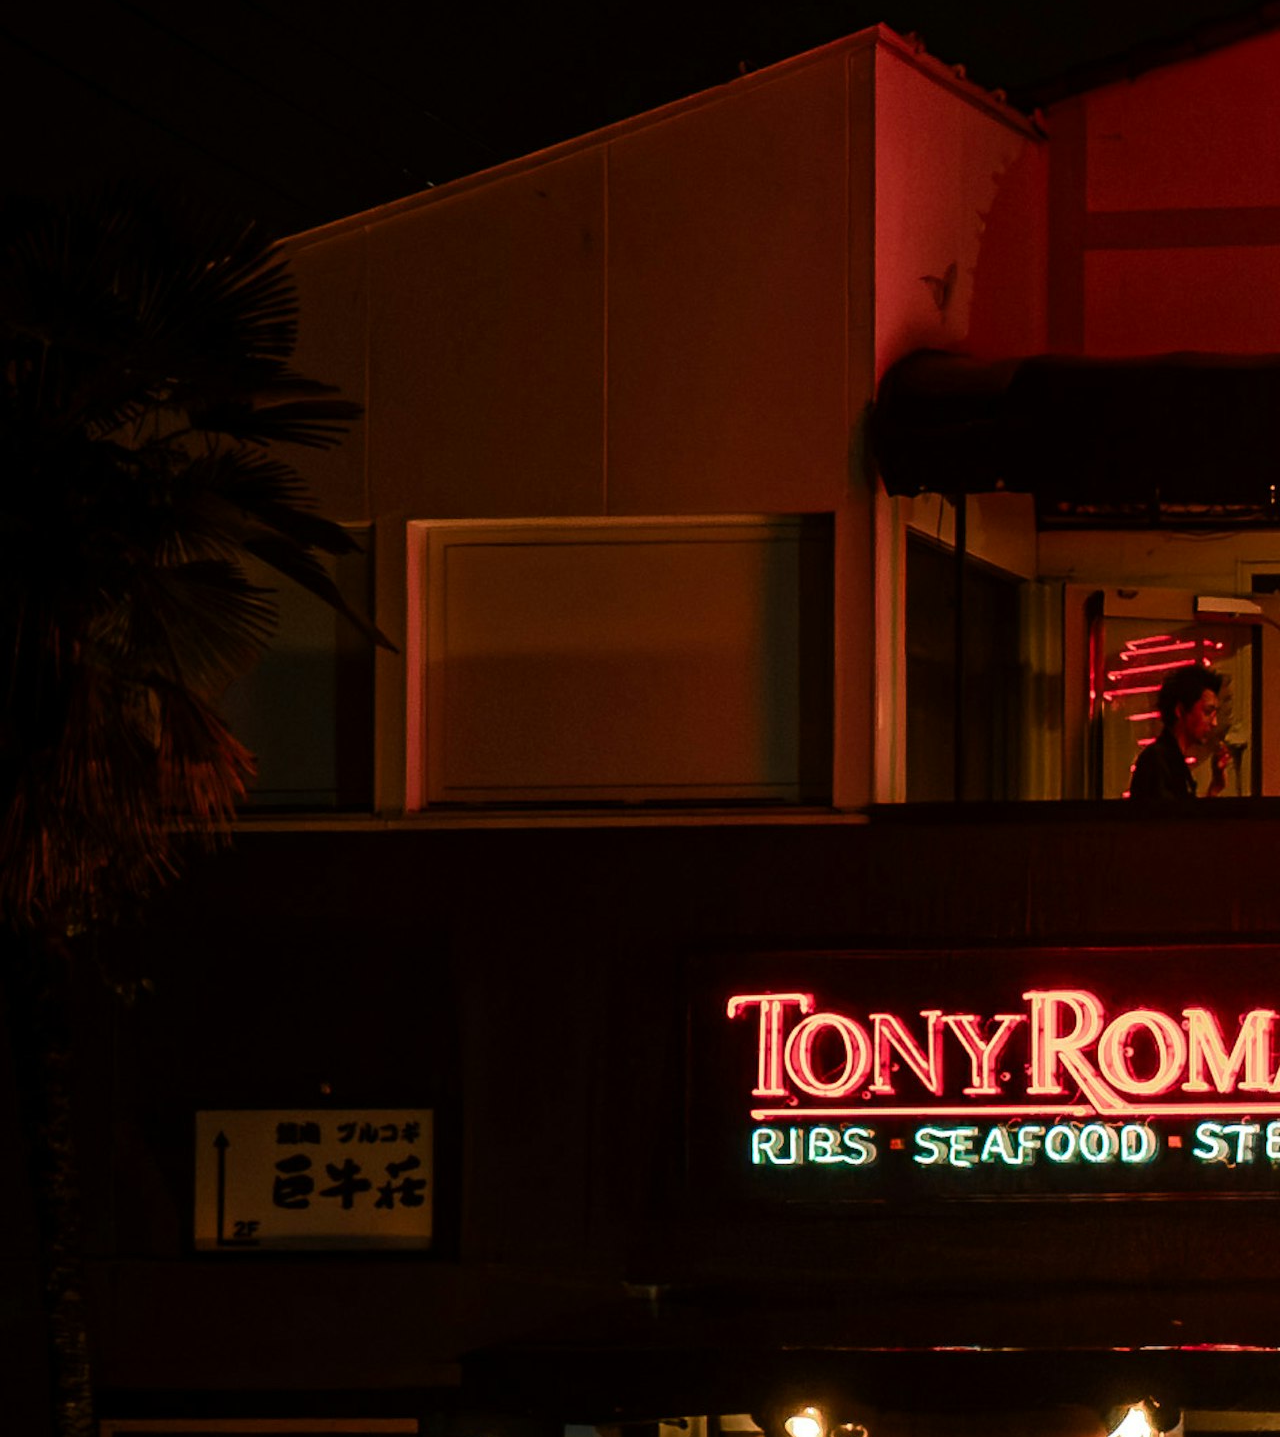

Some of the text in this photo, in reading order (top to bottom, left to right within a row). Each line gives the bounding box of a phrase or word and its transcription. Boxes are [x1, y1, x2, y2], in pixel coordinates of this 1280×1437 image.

[728, 991, 1026, 1097] TONY
[751, 1126, 875, 1166] RIBS
[914, 1122, 1160, 1167] SEAFOOD
